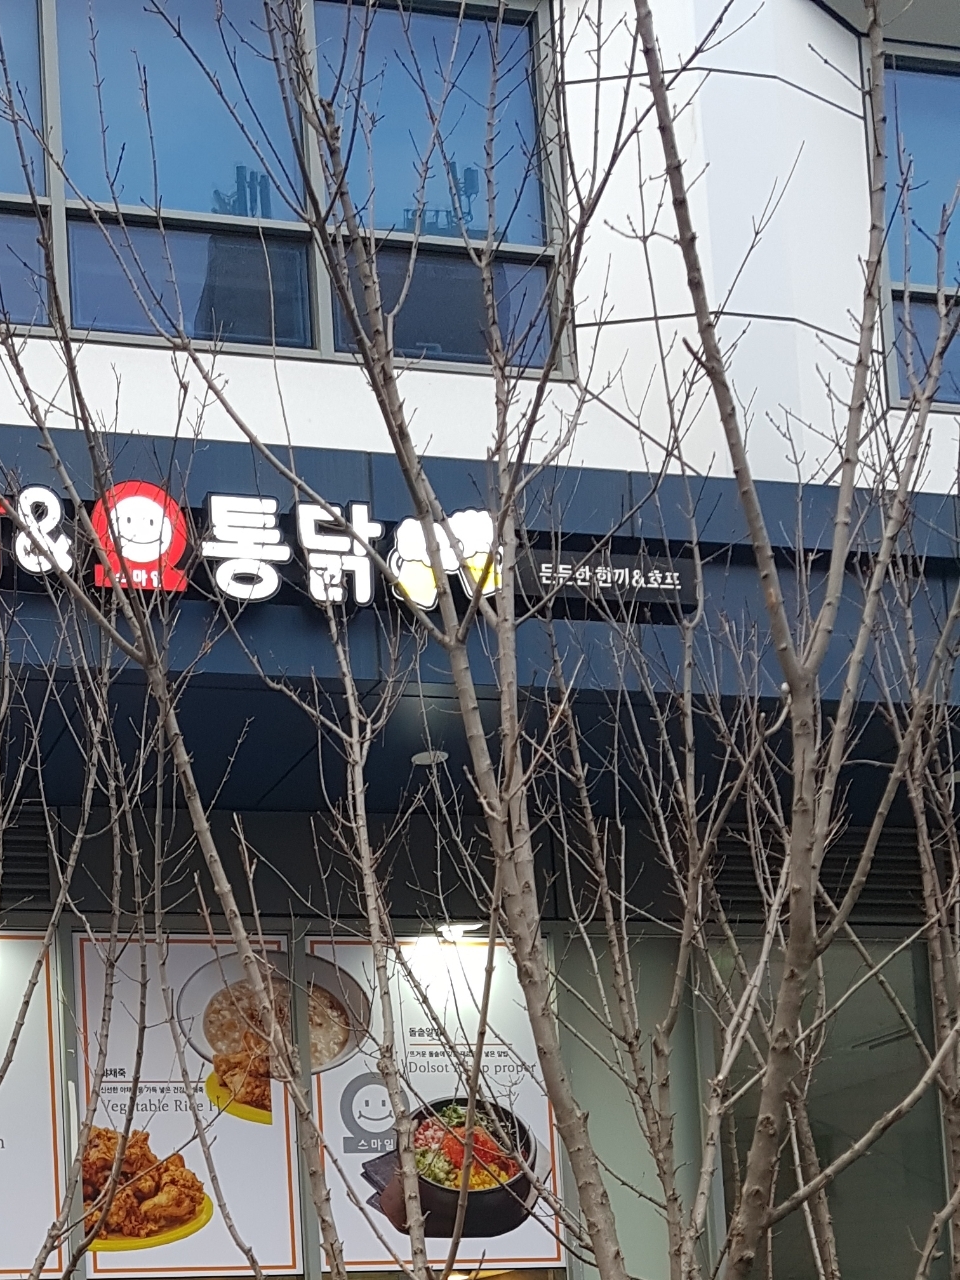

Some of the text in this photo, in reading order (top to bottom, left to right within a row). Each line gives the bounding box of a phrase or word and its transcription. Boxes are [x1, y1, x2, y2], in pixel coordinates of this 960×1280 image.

[408, 1061, 450, 1073] Dolsot
[101, 1098, 169, 1115] Vegtable
[357, 1138, 395, 1151] 스마일
